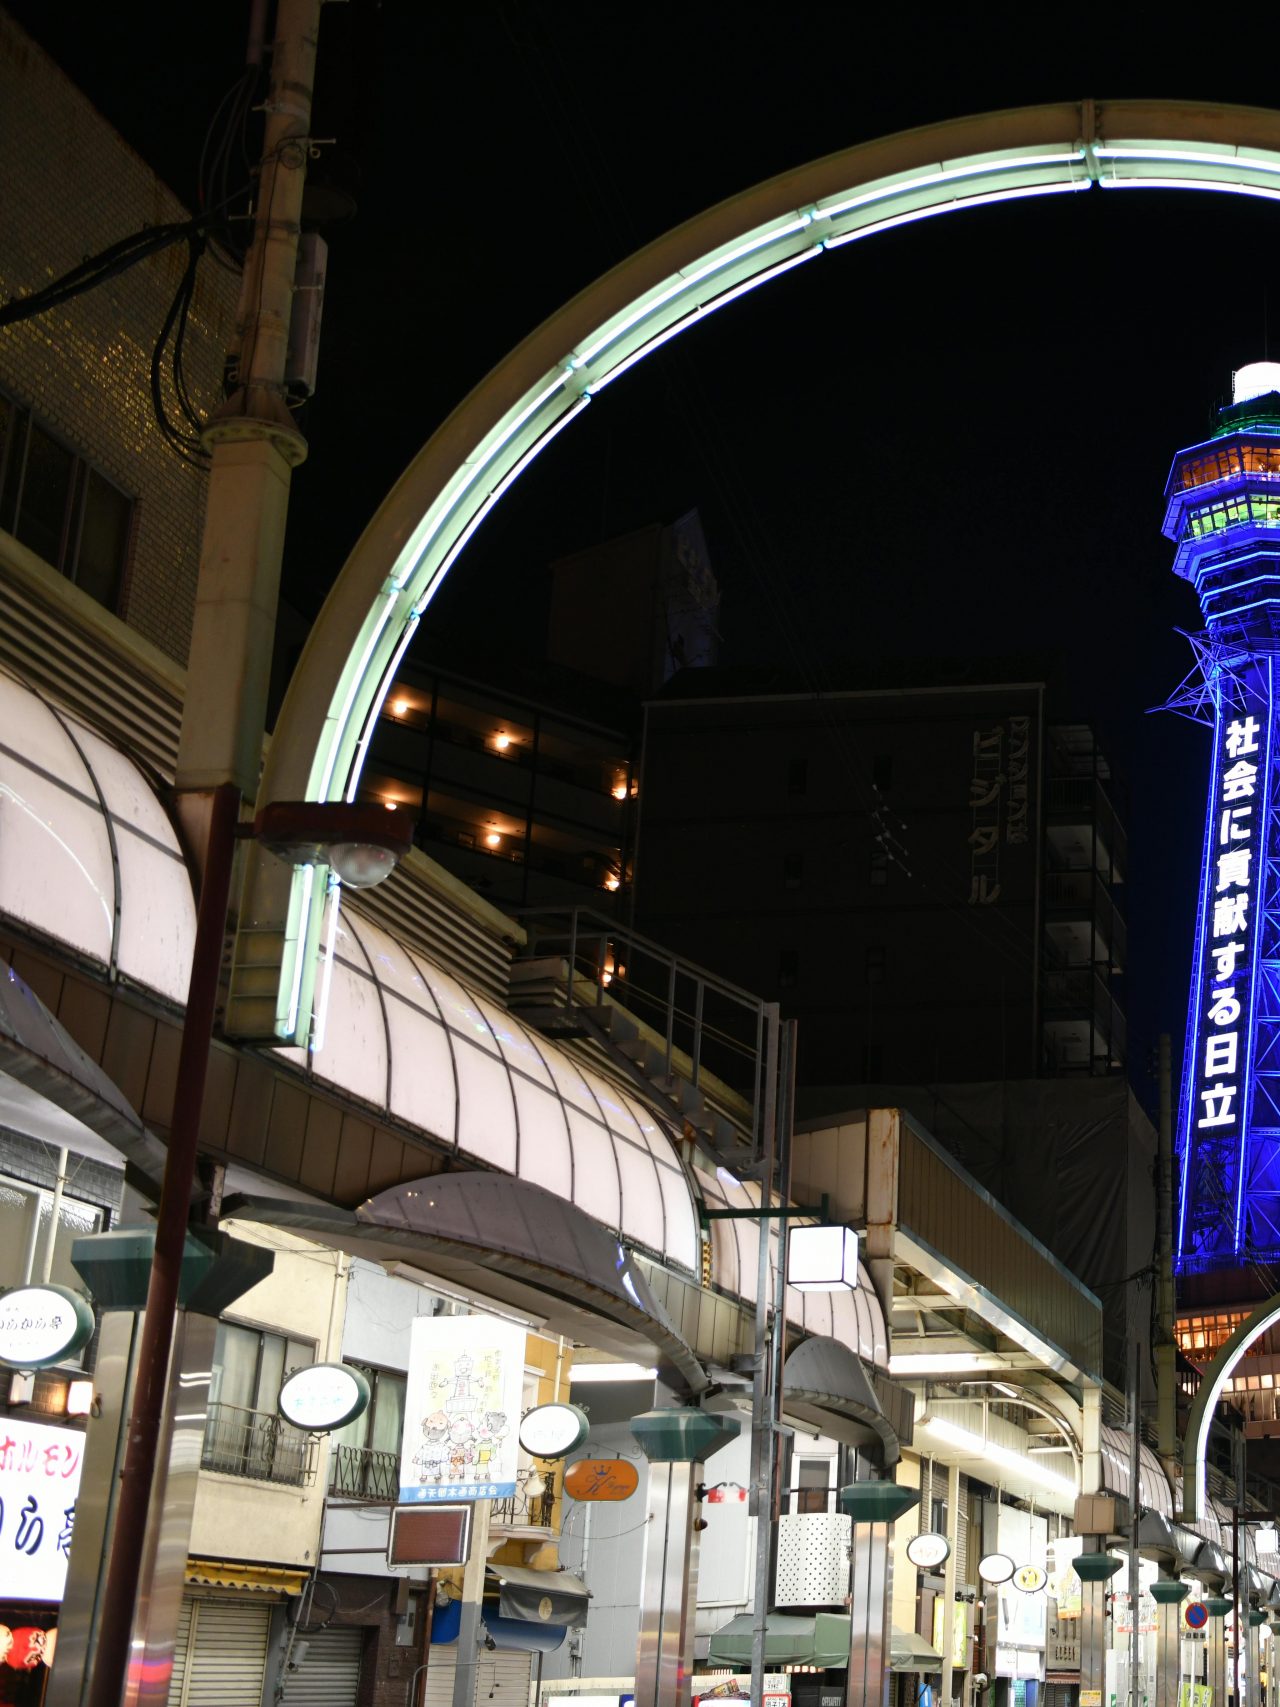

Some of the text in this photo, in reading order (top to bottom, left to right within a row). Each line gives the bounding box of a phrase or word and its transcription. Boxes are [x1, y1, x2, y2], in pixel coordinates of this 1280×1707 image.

[1197, 715, 1260, 1129] 社会に貢献する日立
